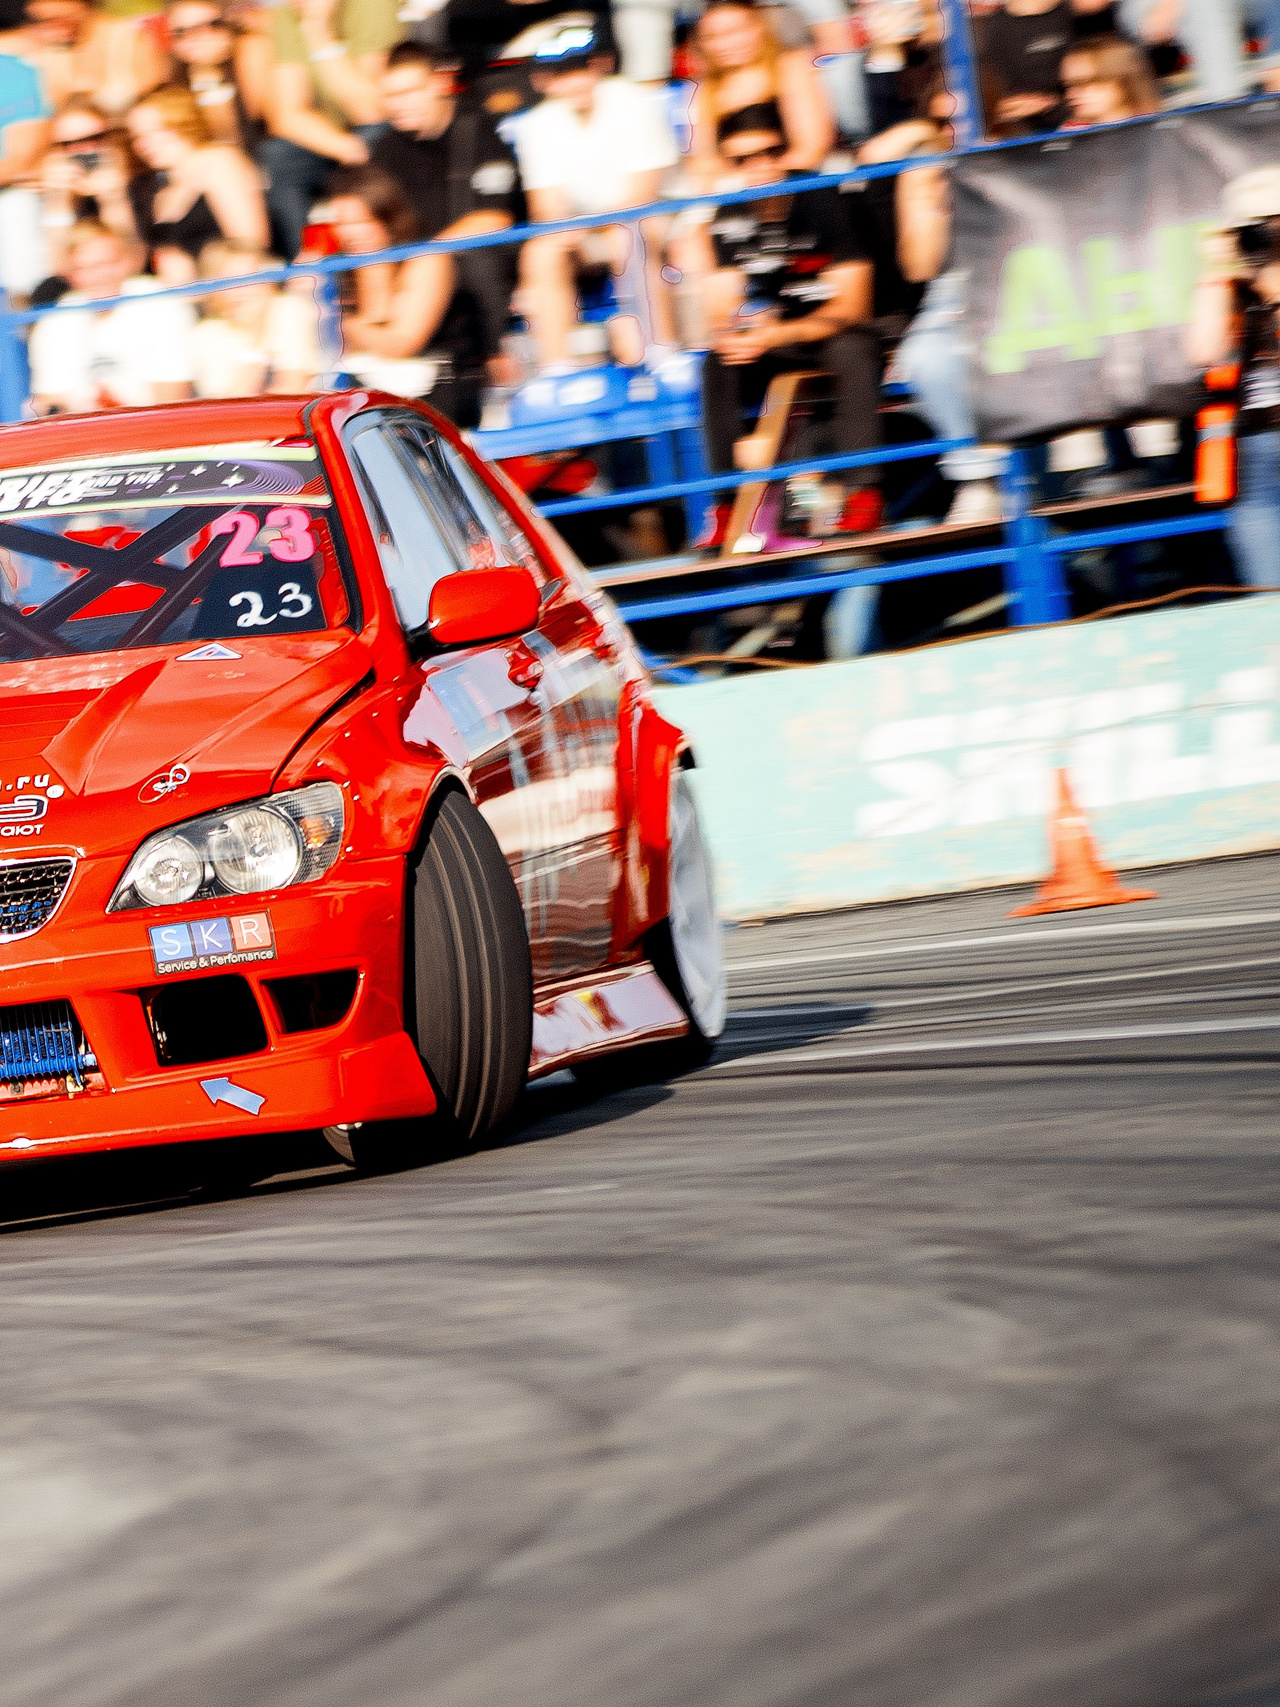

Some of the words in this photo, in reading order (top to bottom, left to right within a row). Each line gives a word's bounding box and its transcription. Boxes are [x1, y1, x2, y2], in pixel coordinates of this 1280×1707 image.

[213, 506, 316, 568] 23
[228, 581, 313, 628] 23
[160, 917, 264, 956] SKR
[158, 959, 197, 974] Service
[198, 955, 208, 968] &
[210, 950, 274, 966] Perfomance
